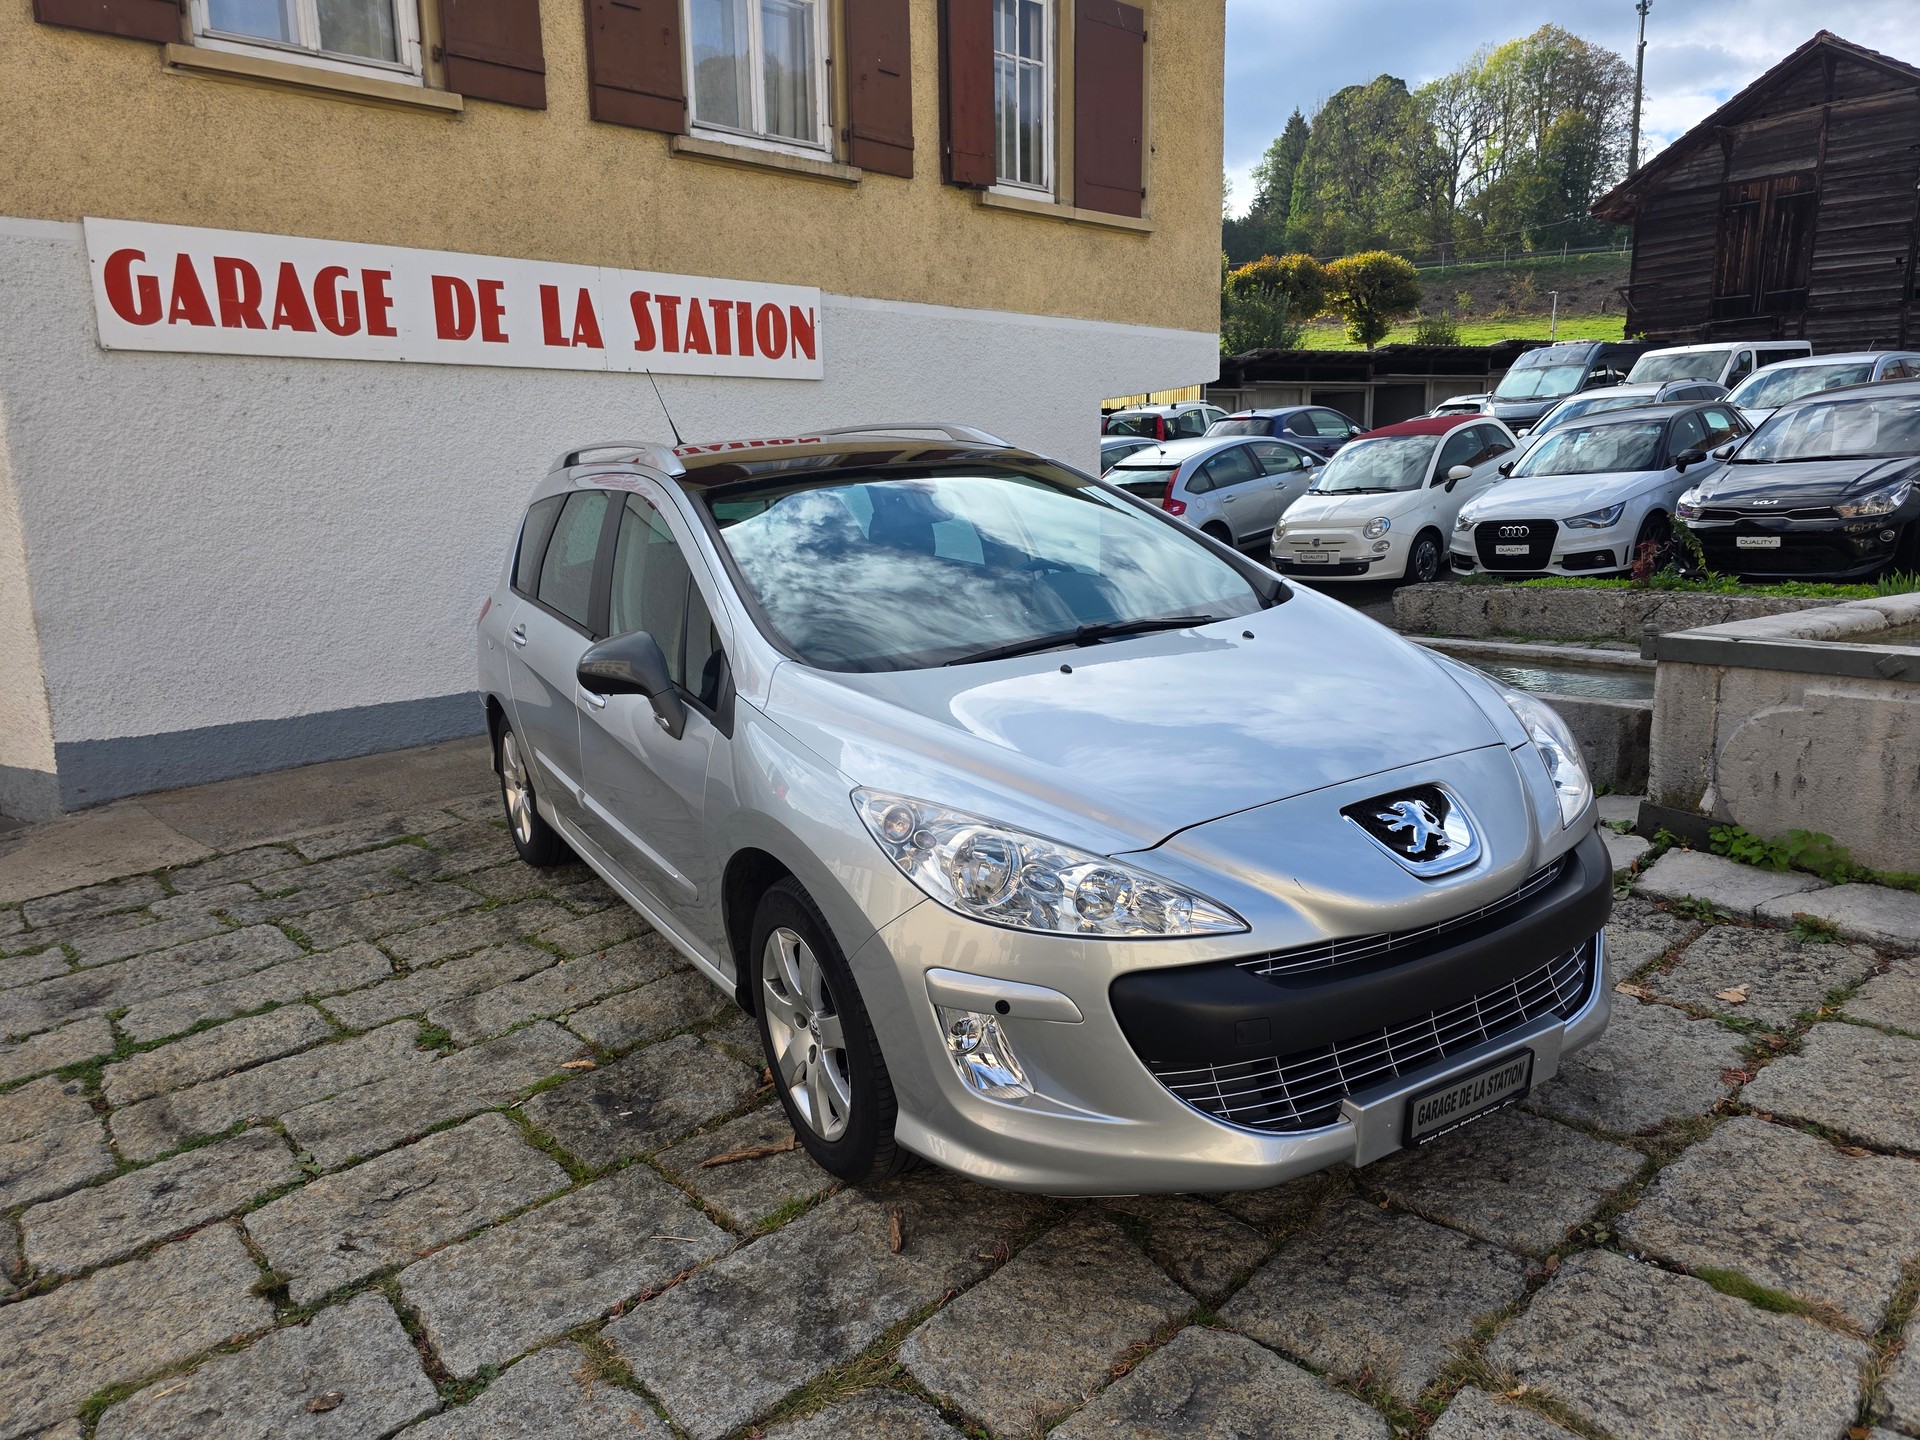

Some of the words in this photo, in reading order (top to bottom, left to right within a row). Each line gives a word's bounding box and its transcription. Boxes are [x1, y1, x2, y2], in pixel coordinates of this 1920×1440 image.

[104, 248, 398, 336] GARAGE
[431, 275, 509, 343] DE
[540, 284, 604, 348] LA
[630, 290, 816, 360] STATION
[1418, 1092, 1458, 1126] GARAGE
[1458, 1084, 1473, 1109] DE
[1473, 1079, 1485, 1102] LA
[1487, 1061, 1525, 1096] STATION
